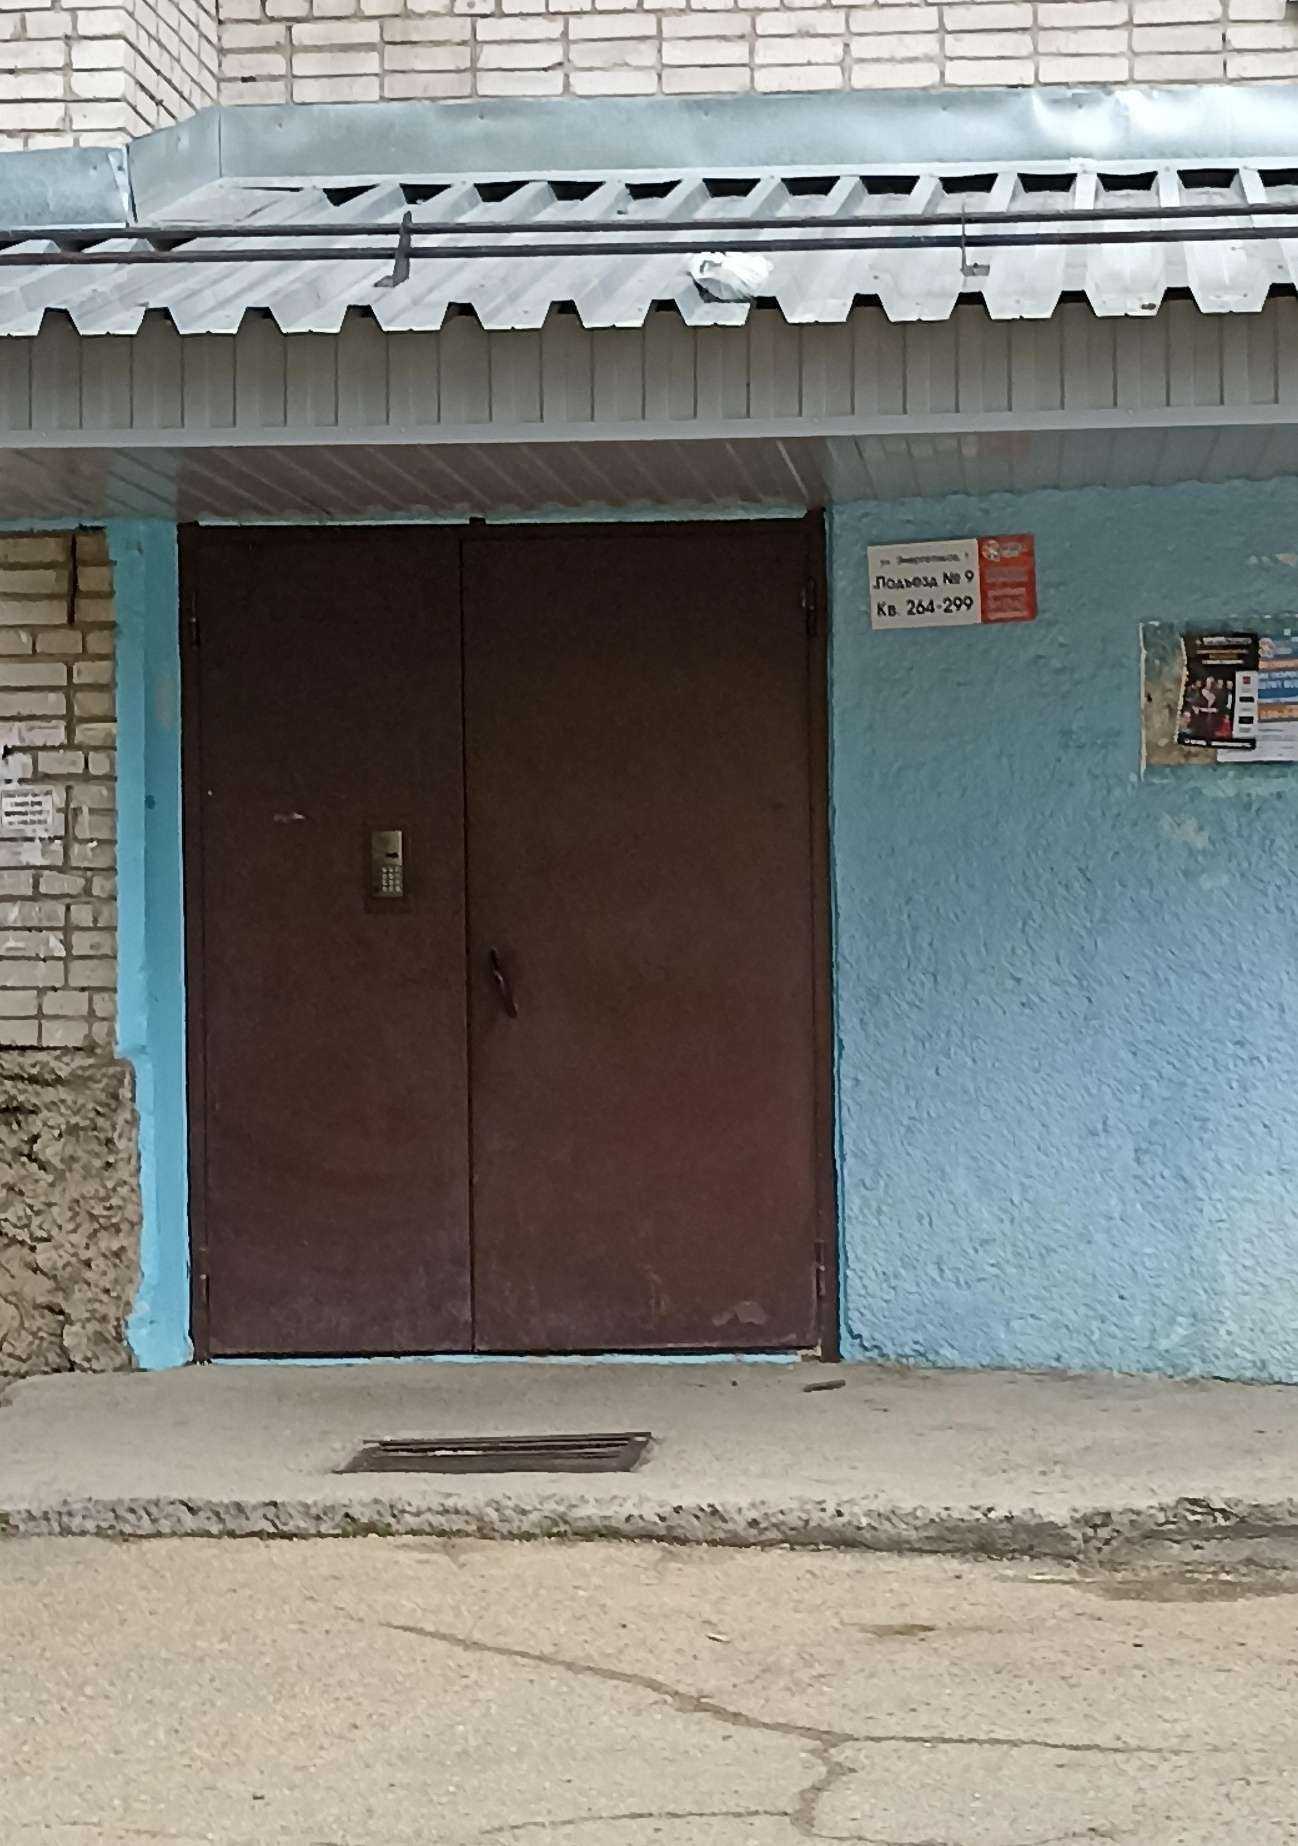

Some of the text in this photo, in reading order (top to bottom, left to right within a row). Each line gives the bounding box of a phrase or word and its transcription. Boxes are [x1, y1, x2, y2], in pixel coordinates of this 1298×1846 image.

[874, 575, 938, 590] Подъезд
[943, 571, 961, 585] №
[964, 569, 974, 583] 9
[906, 596, 974, 616] 264-299
